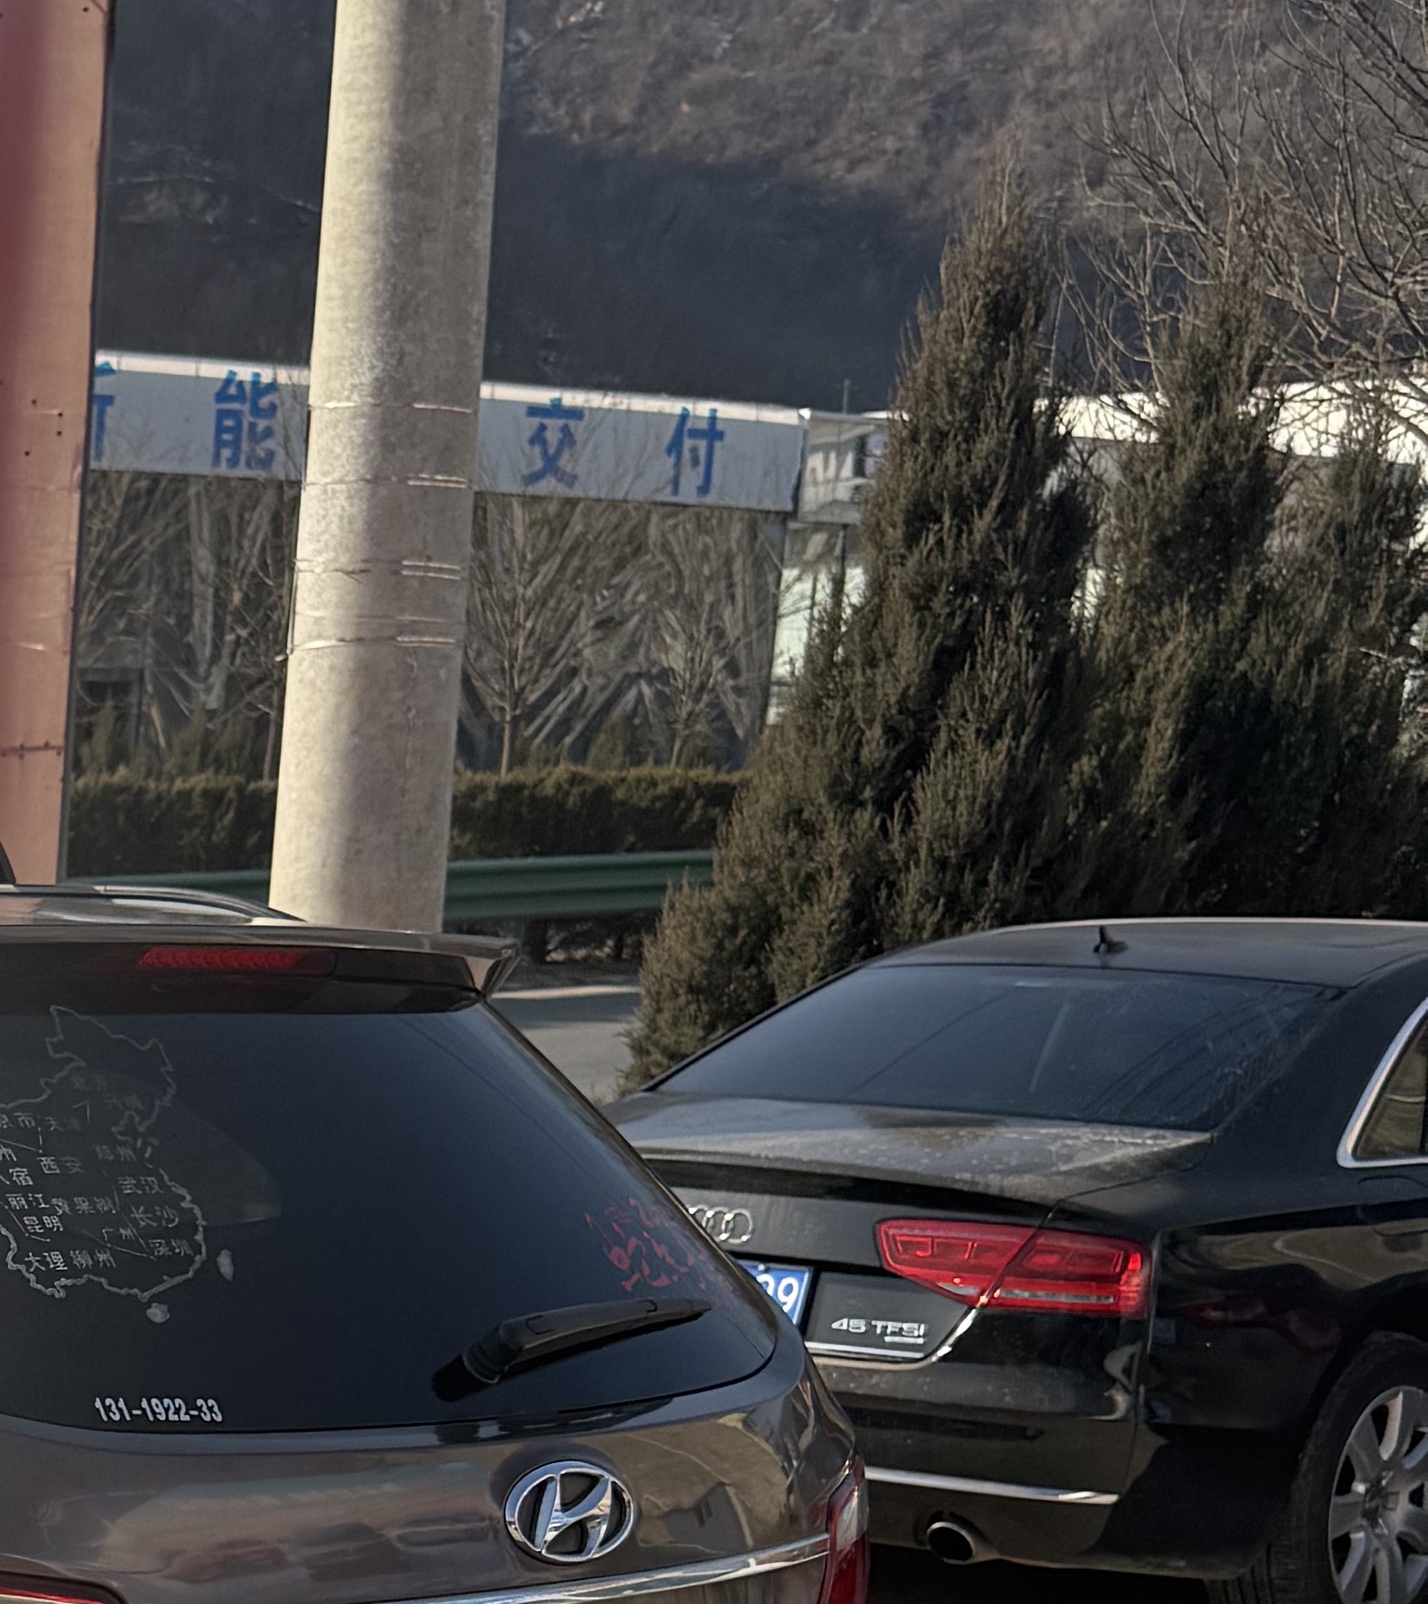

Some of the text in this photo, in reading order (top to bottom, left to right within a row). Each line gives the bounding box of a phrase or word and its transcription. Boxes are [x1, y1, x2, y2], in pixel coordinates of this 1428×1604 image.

[35, 1156, 85, 1175] 西安
[117, 1176, 165, 1194] 武汉
[5, 1193, 51, 1211] 丽江
[22, 1214, 64, 1233] 昆明
[131, 1204, 180, 1228] 长沙
[148, 1239, 195, 1257] 深圳
[24, 1250, 68, 1272] 大理
[831, 1317, 925, 1337] 45 TFSI
[94, 1397, 223, 1423] 131-1922-33
